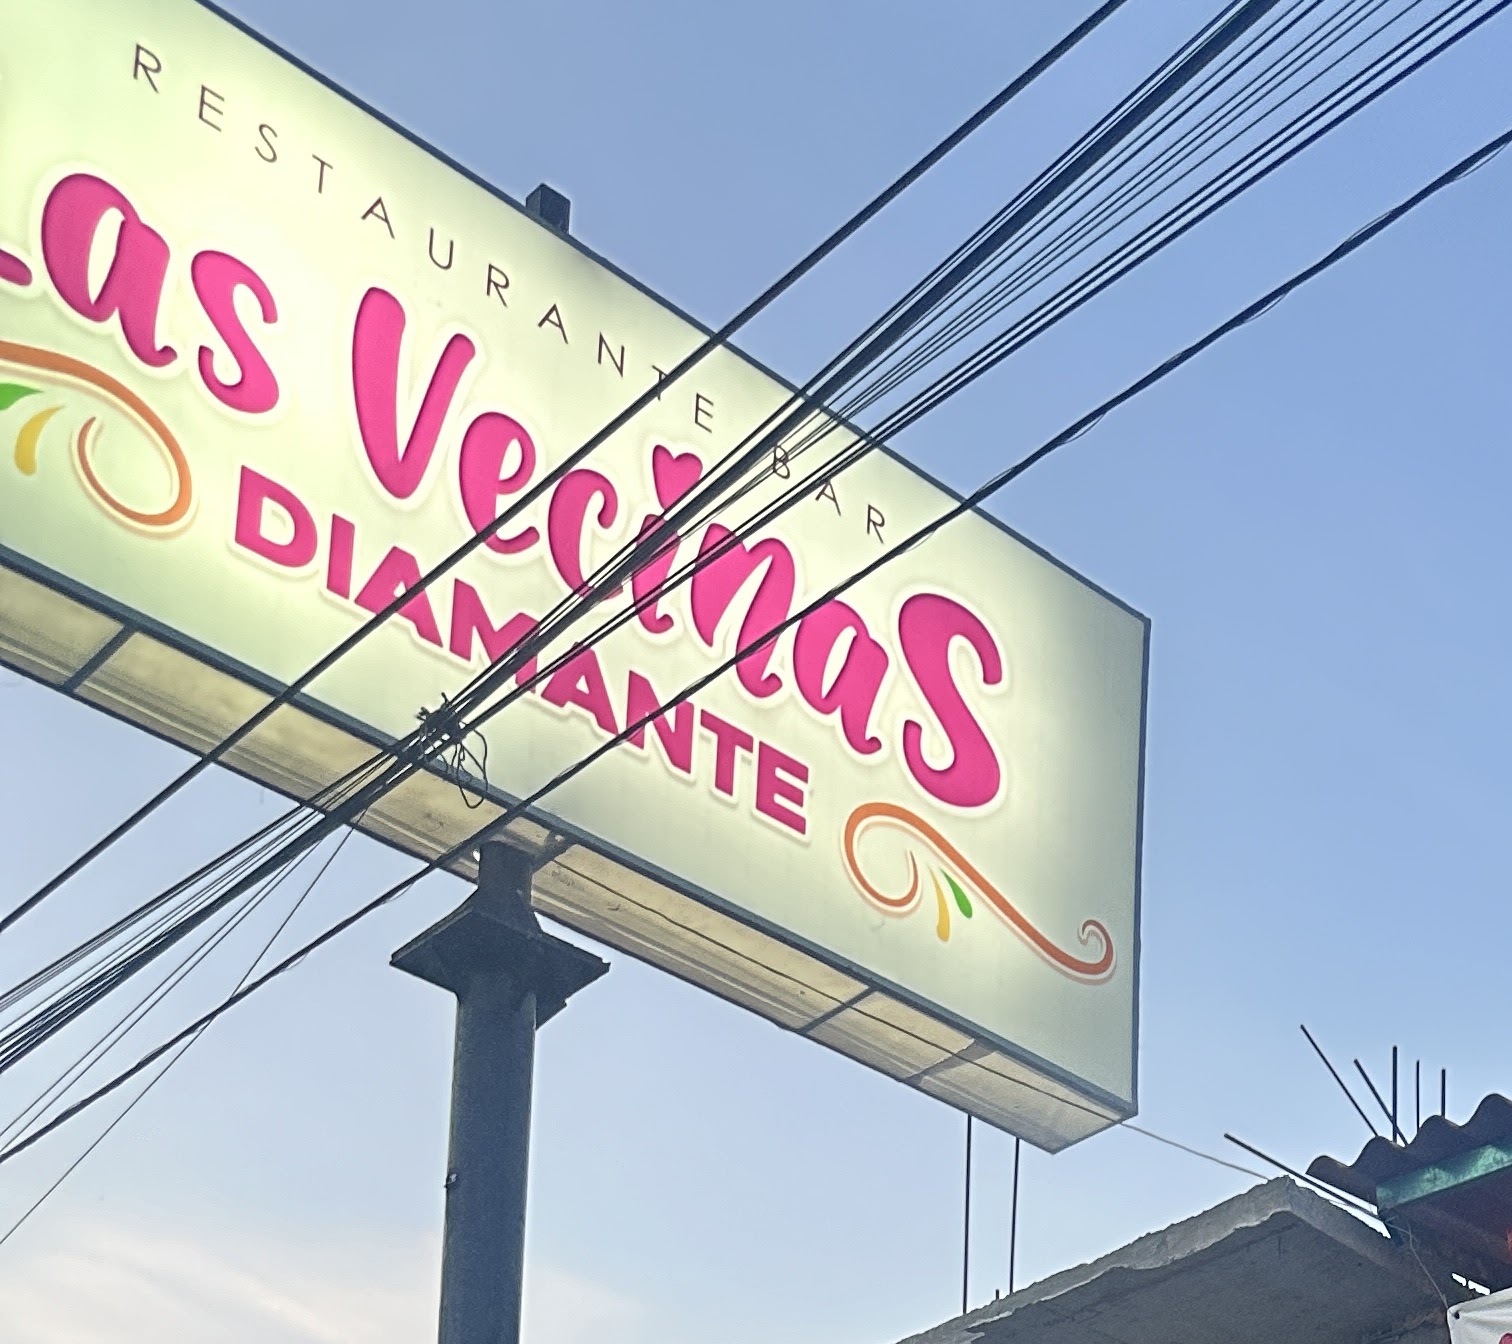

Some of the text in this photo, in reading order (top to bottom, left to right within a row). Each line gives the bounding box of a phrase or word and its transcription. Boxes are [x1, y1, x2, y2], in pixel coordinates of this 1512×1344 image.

[0, 173, 1002, 807] as Vecinas
[133, 44, 886, 544] RESTAURANTE BAR
[234, 465, 809, 834] DIAMANTE
